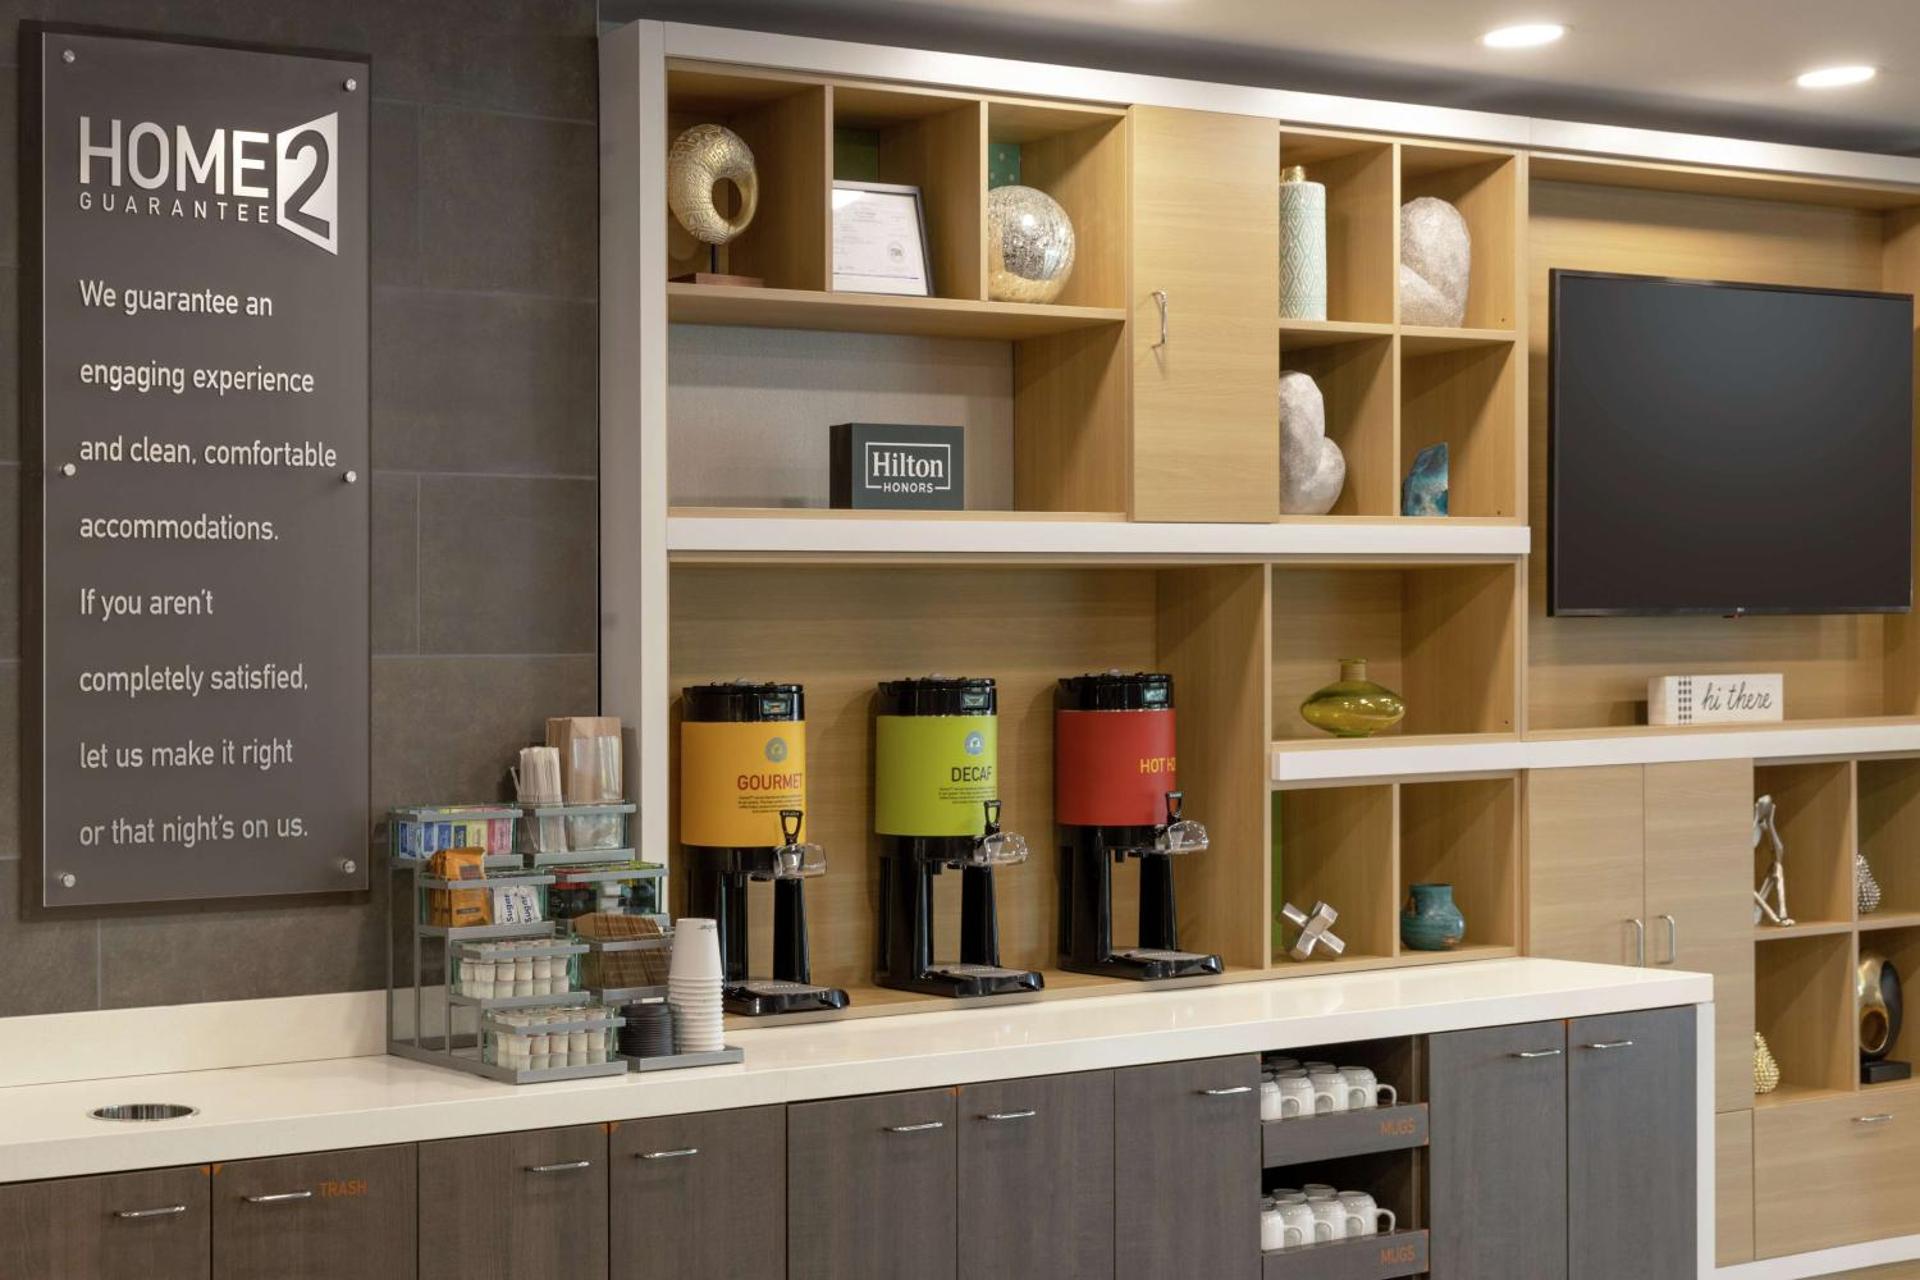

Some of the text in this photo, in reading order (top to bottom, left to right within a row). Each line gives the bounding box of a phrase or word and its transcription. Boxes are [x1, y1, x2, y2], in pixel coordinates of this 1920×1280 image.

[79, 192, 269, 223] GUARANTEE
[79, 280, 273, 316] We guarantee an
[80, 360, 314, 396] engaging experience
[80, 435, 337, 467] and clean, comfortable
[872, 451, 944, 478] Hilton
[883, 482, 934, 493] HONORS
[80, 513, 279, 540] accommodations.
[80, 588, 214, 621] If you aren't
[79, 664, 308, 698] completely satisfied,
[1702, 680, 1773, 711] hi there
[80, 738, 293, 770] let us make it right
[1139, 757, 1166, 774] HOT
[737, 773, 803, 791] GOURMET
[951, 766, 993, 782] DECAF
[80, 814, 308, 848] or that night's on us.
[504, 894, 514, 922] Sugar
[1379, 1117, 1416, 1136] MUGS
[318, 1179, 369, 1198] TRASH
[1379, 1244, 1416, 1265] MUGS
